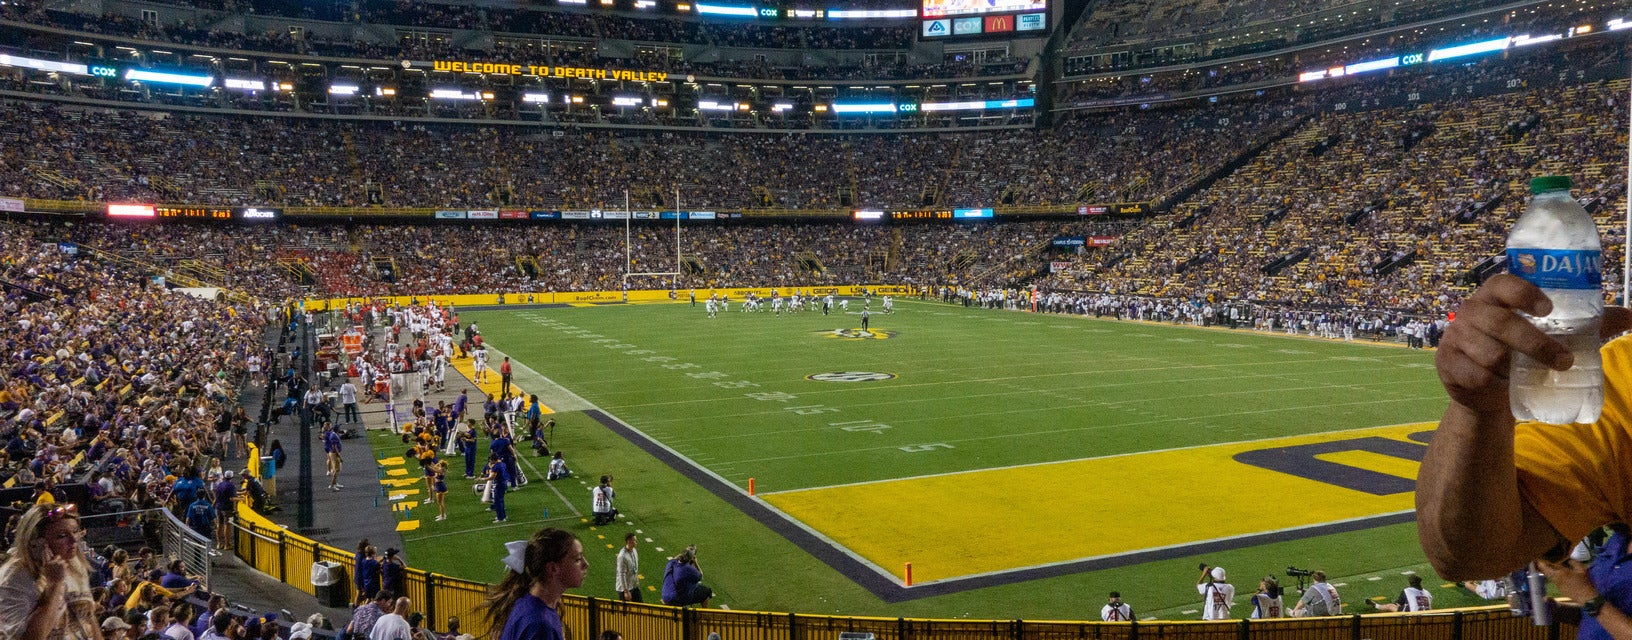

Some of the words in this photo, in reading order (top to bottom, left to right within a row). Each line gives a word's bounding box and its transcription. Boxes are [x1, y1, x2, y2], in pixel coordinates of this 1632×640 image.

[955, 21, 981, 31] COX
[1402, 53, 1423, 64] COX
[92, 66, 116, 77] COX
[434, 60, 522, 75] WELCOME
[528, 65, 549, 76] TO
[555, 67, 606, 79] DEATH
[612, 70, 668, 82] VALLEY
[1407, 93, 1420, 101] 101
[1334, 103, 1347, 111] 100
[591, 209, 602, 218] 25
[1541, 252, 1601, 277] DASAN
